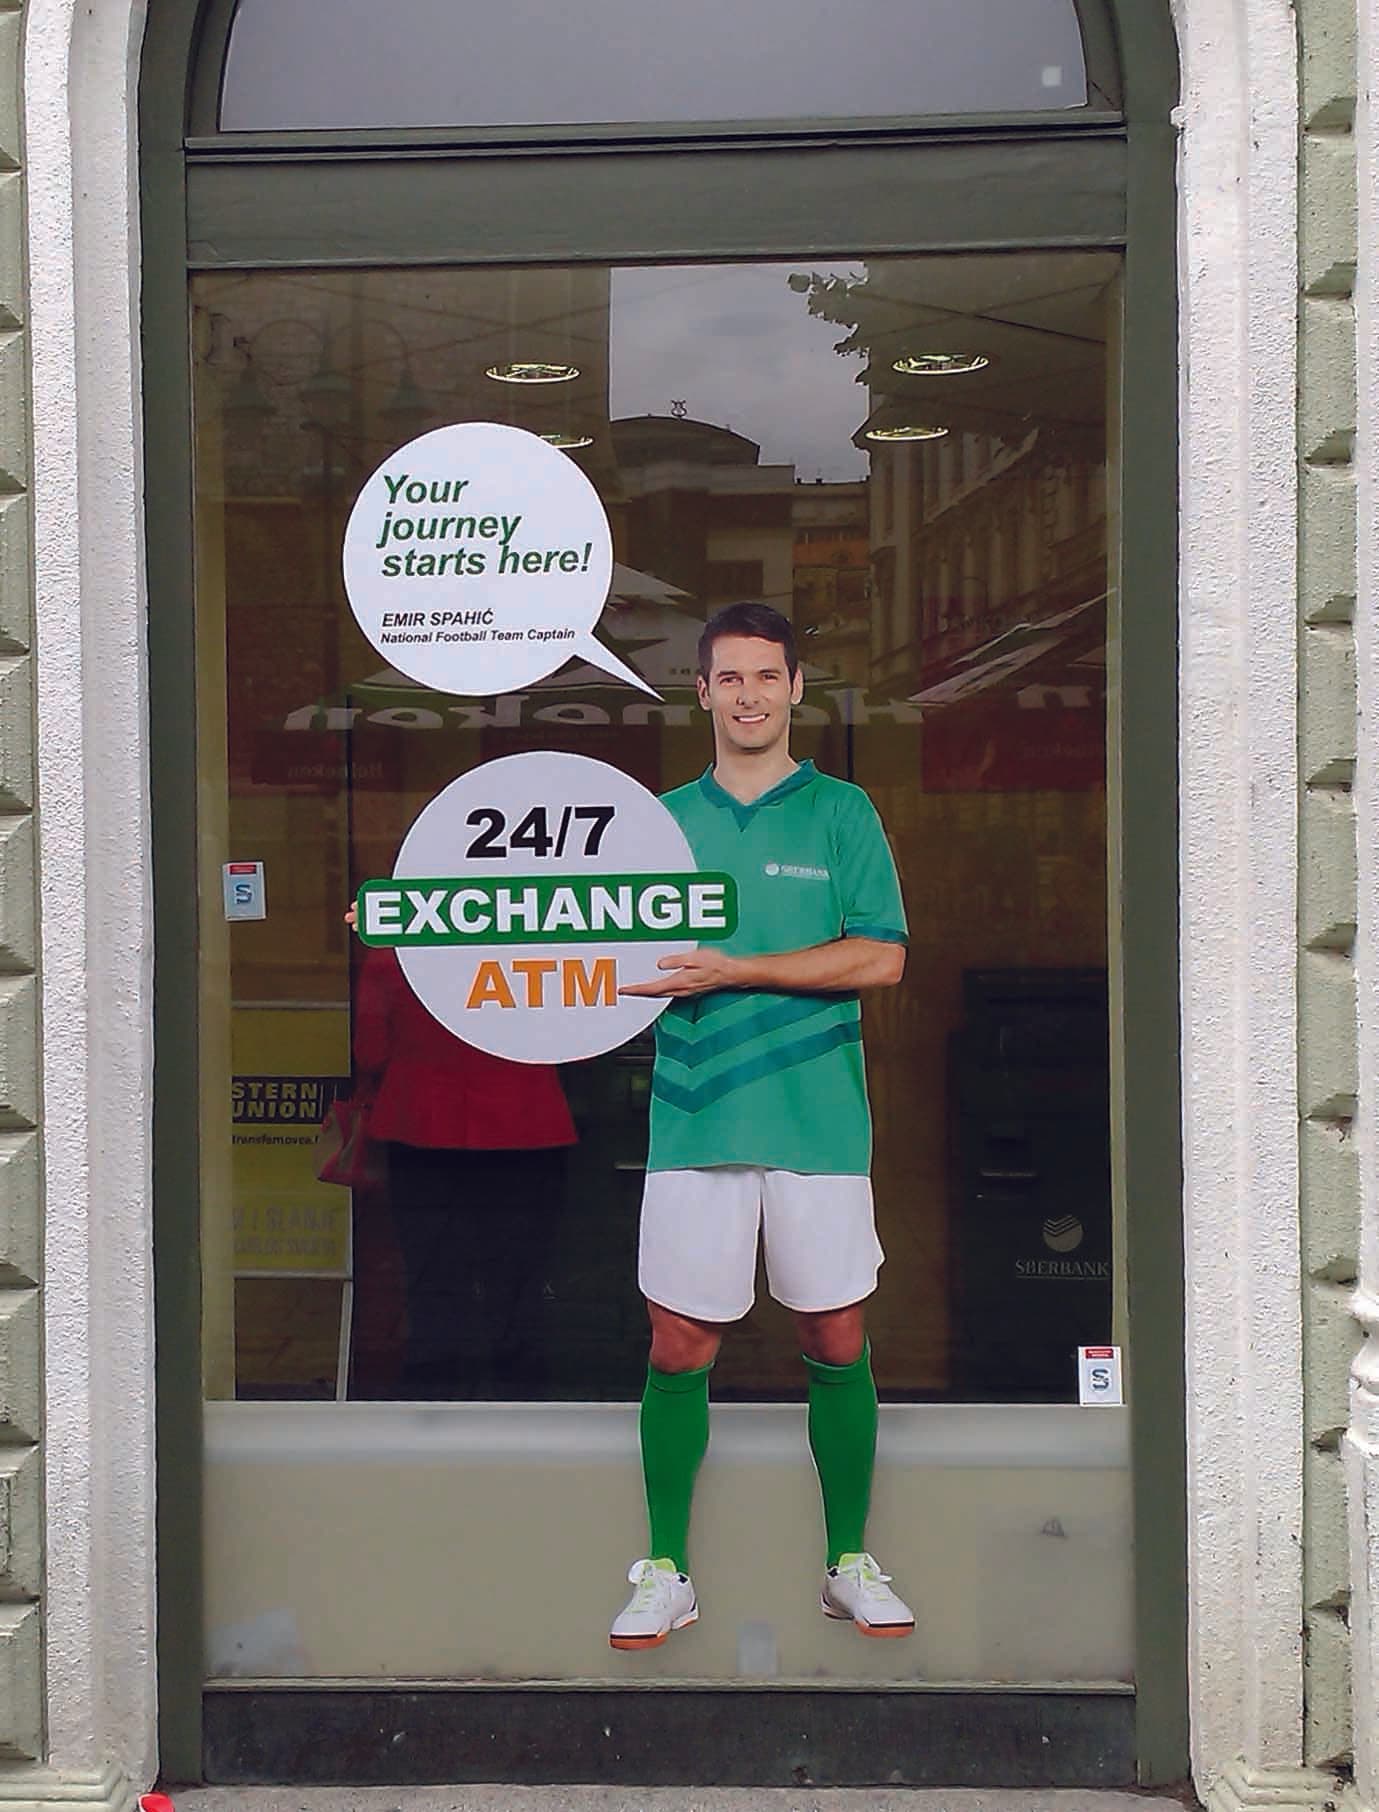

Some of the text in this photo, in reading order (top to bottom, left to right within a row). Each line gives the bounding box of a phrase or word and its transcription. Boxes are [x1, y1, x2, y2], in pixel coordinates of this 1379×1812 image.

[383, 474, 470, 505] Your
[375, 511, 523, 549] journey
[381, 542, 593, 577] starts here!
[381, 607, 495, 628] EMIR SPAHIĆ
[380, 627, 576, 644] National Football Team Captain
[465, 805, 616, 859] 24/7
[364, 884, 726, 936] EXCHANGE
[466, 958, 618, 1010] ATM
[231, 1101, 317, 1118] UNION
[1015, 1259, 1110, 1276] SBERBANK
